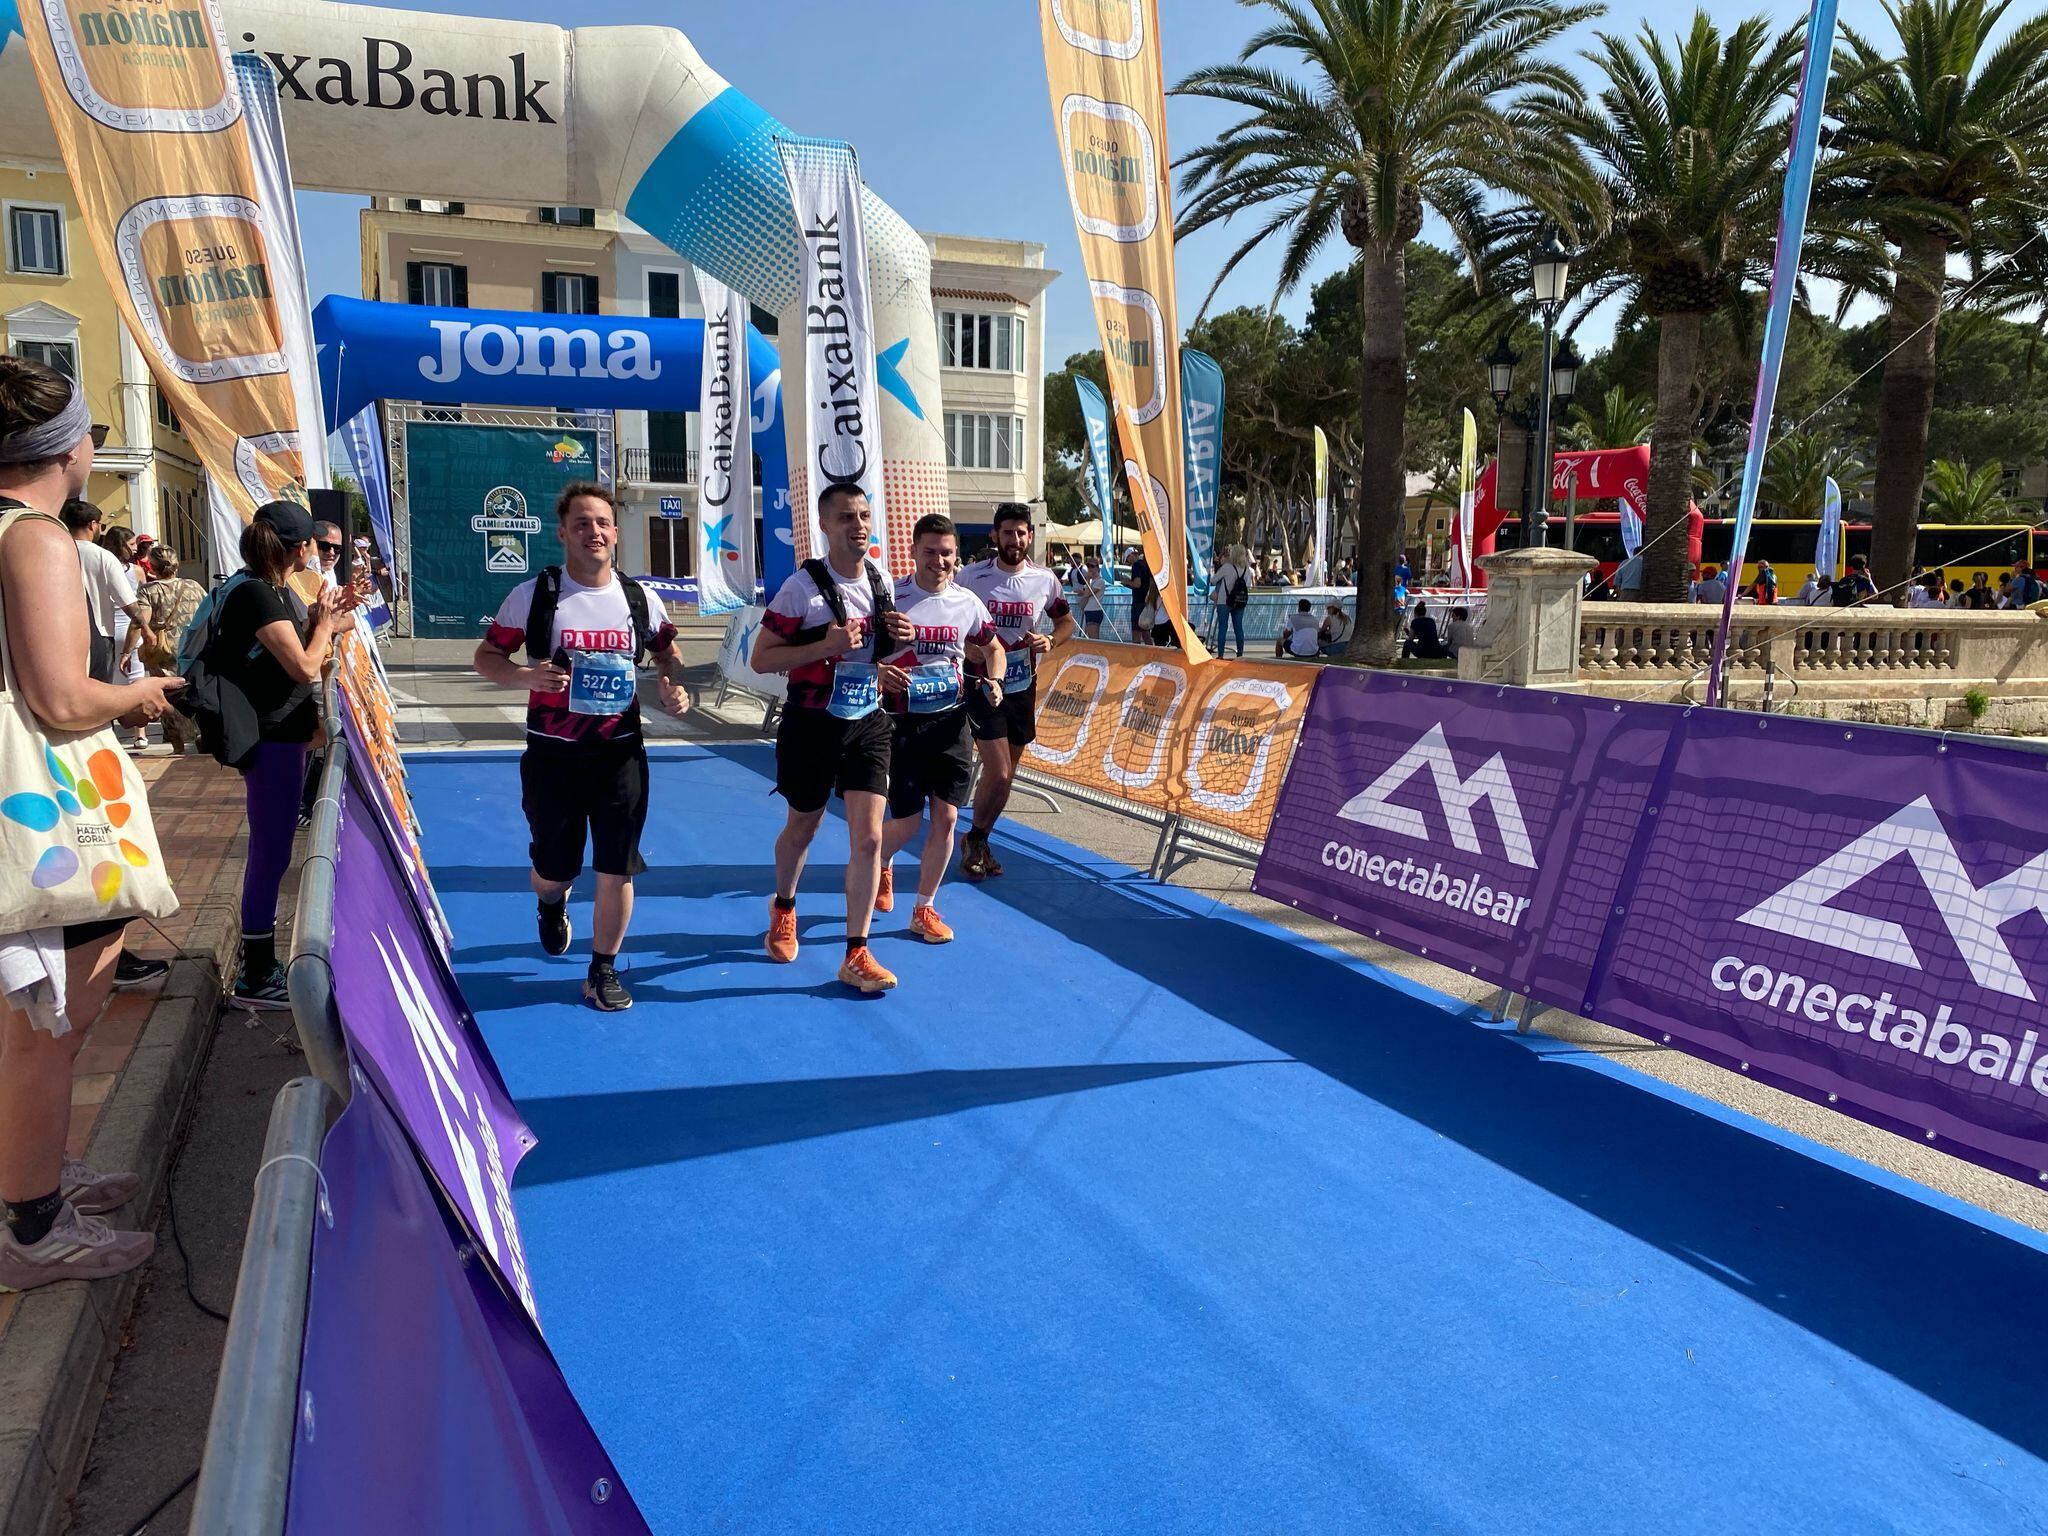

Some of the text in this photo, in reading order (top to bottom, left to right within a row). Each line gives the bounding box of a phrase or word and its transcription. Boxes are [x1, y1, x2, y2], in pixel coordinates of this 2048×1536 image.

[417, 319, 662, 384] Joma
[806, 209, 867, 484] CaixaBank
[703, 306, 732, 507] CaixaBank
[662, 499, 681, 510] TAXI
[505, 520, 536, 529] CAVALLS
[988, 601, 1033, 615] PATIOS
[997, 615, 1021, 628] RUN
[563, 631, 630, 649] PATIOS
[916, 627, 958, 641] ATIOS
[919, 642, 945, 654] RUN
[1016, 665, 1023, 676] A
[581, 674, 622, 691] 527 C
[841, 682, 861, 696] 527
[915, 681, 947, 695] 527 D
[1321, 837, 1532, 928] conectabalear
